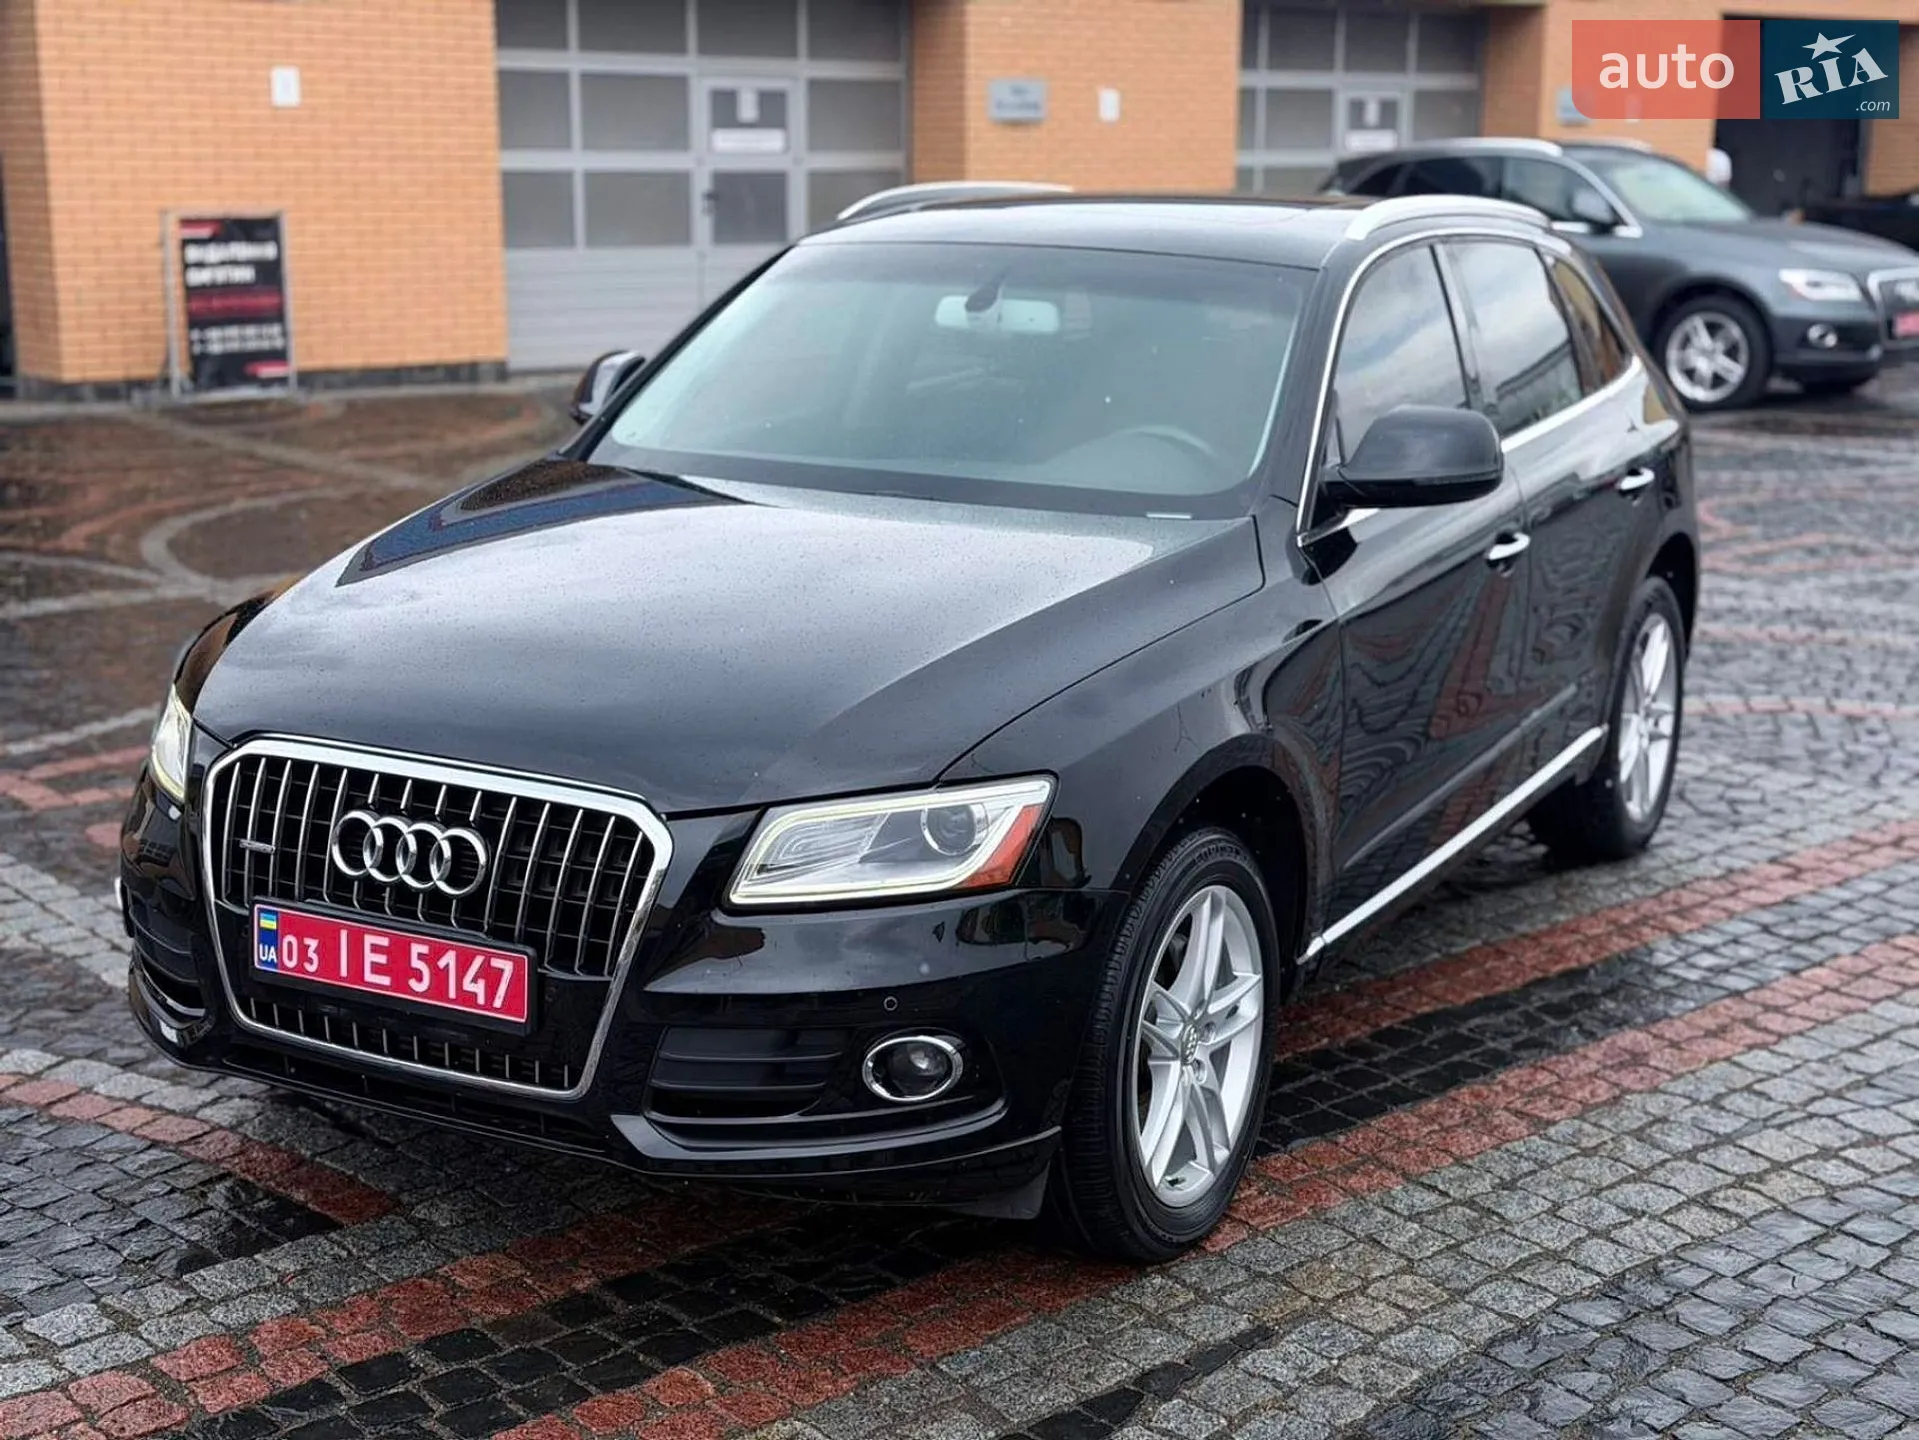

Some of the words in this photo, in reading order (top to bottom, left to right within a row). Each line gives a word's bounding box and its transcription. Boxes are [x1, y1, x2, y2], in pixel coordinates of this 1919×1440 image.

[259, 943, 278, 963] UA
[282, 934, 319, 973] 03
[339, 929, 391, 986] IE
[408, 942, 514, 1009] 5147
